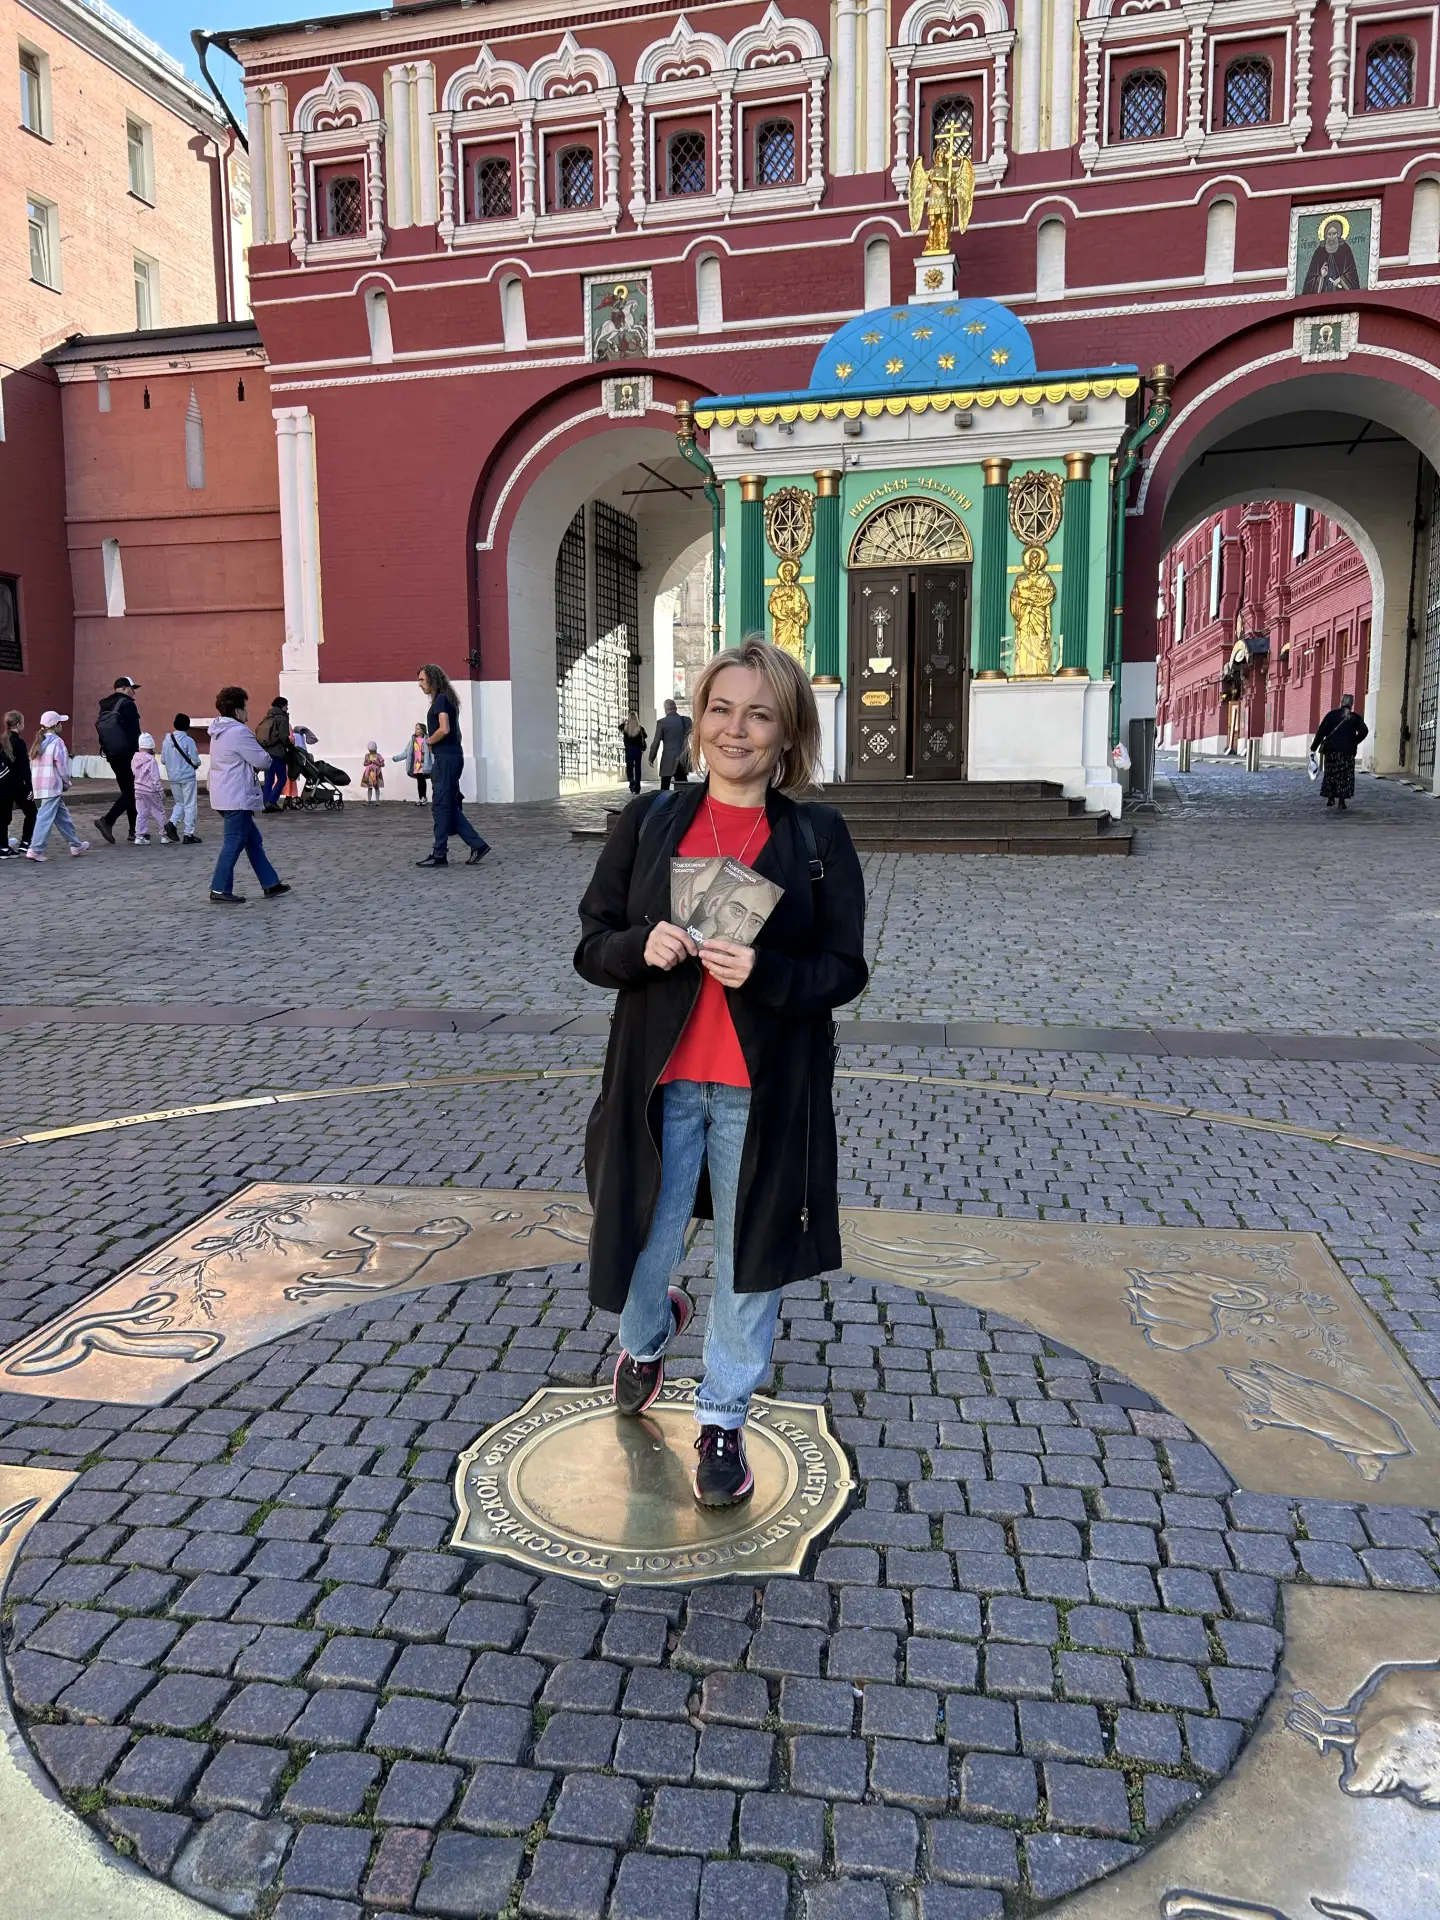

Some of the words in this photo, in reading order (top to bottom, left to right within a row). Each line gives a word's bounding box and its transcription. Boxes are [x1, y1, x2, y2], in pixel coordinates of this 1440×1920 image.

[107, 1108, 198, 1127] ВОСТОК
[483, 1392, 616, 1466] ФЕДЕРАЦИИ
[771, 1419, 828, 1506] КИЛОМЕТР
[470, 1477, 611, 1570] РОССИЙСКОЙ
[625, 1513, 802, 1572] АВТОДОРОГ
